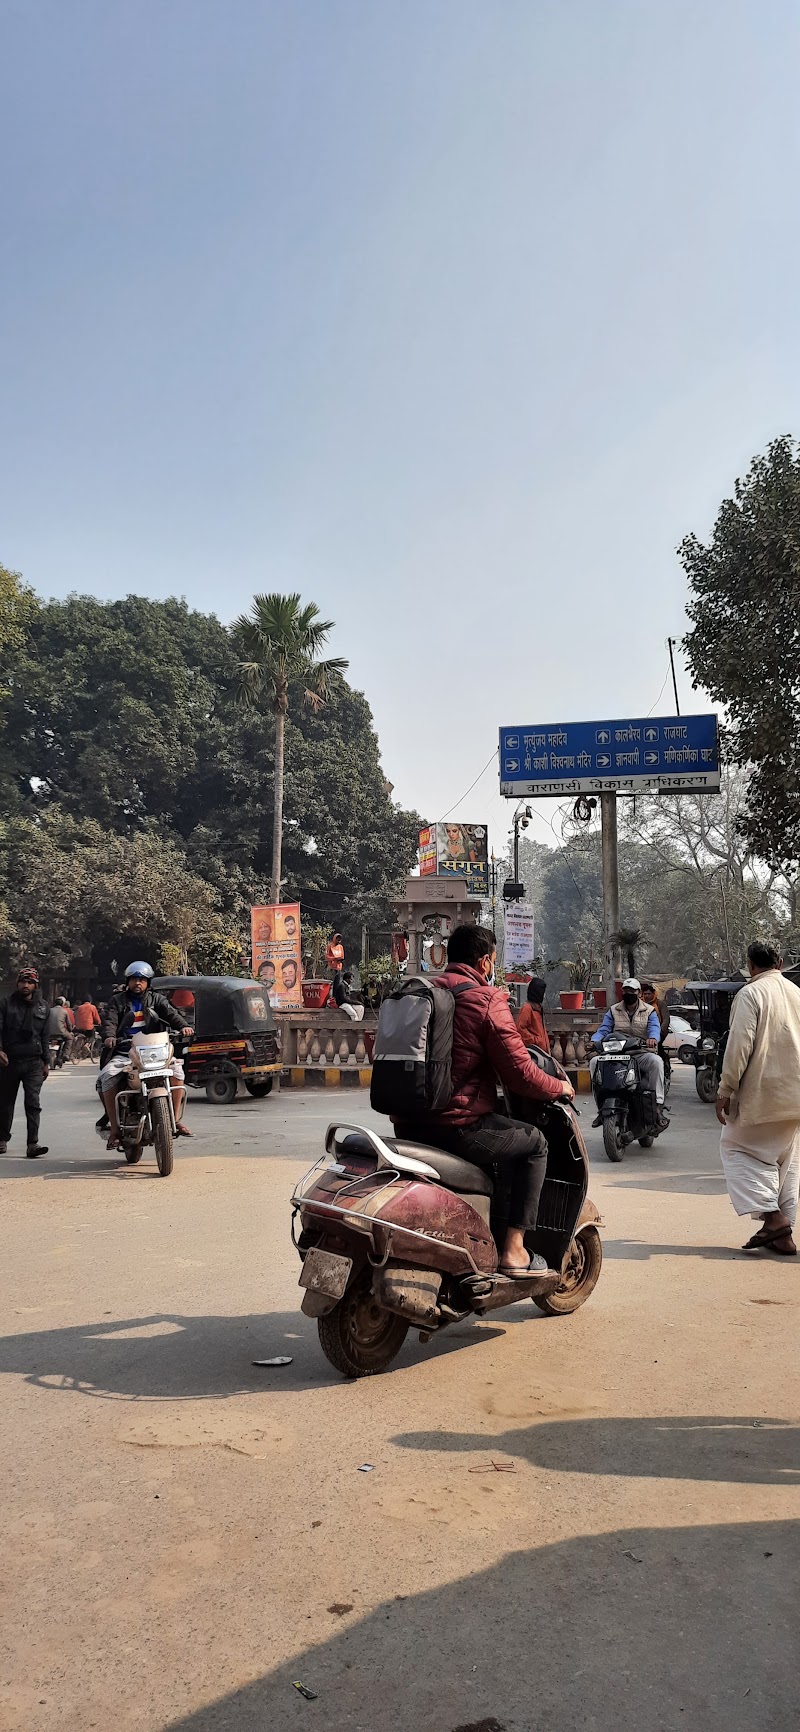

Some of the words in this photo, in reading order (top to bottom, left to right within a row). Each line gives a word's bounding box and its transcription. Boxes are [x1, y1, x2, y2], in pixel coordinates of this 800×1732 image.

[523, 732, 546, 753] मृत्युंजय
[548, 728, 568, 747] महादेव
[615, 724, 641, 742] कालभैरव
[663, 725, 688, 740] राजघाट
[524, 753, 532, 771] श्री
[533, 752, 548, 771] काशी
[550, 752, 575, 770] विश्वनाथ
[577, 750, 592, 768] मंदिर
[615, 747, 640, 767] ज्ञानवापी
[664, 745, 699, 764] मणिकर्णिका
[700, 749, 714, 762] घाट
[526, 779, 581, 793] वाराणसी
[589, 778, 634, 790] विकास
